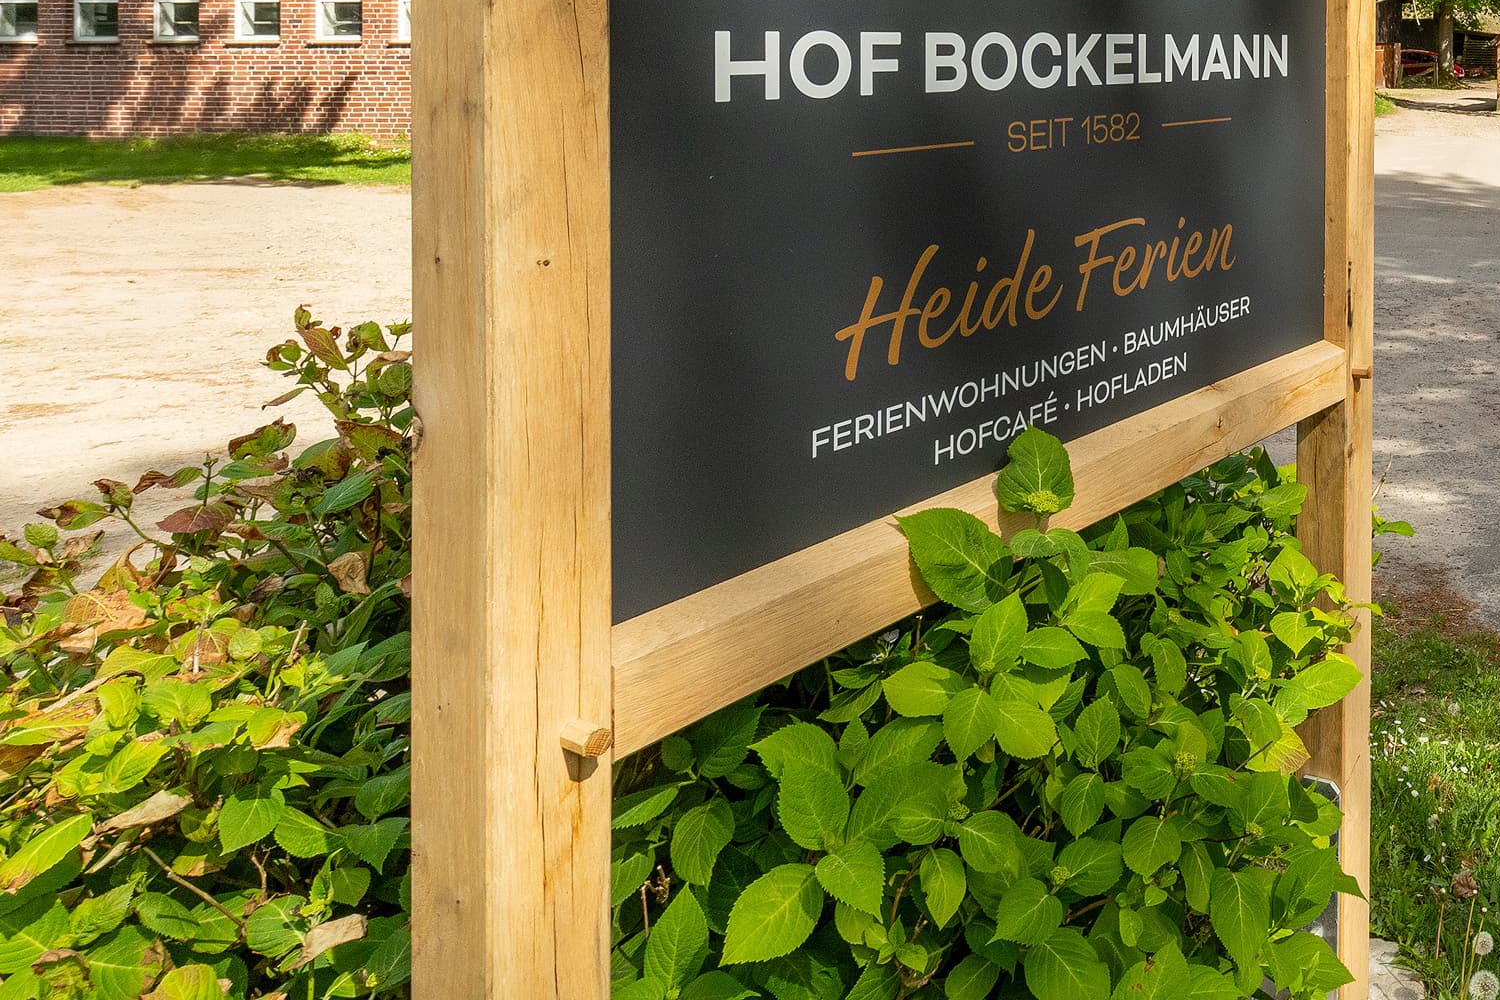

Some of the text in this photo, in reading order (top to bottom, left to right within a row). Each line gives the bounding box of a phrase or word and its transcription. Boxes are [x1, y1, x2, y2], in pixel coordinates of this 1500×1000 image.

[714, 30, 1289, 103] HOF BOCKELMANN
[1007, 113, 1141, 153] SEIT 1582
[834, 217, 1237, 381] Heide Ferien
[811, 295, 1251, 459] FERIENWOHNUNGEN BAUMHÄUSER
[933, 351, 1188, 466] HOFCAFÉ HOFLADEN
